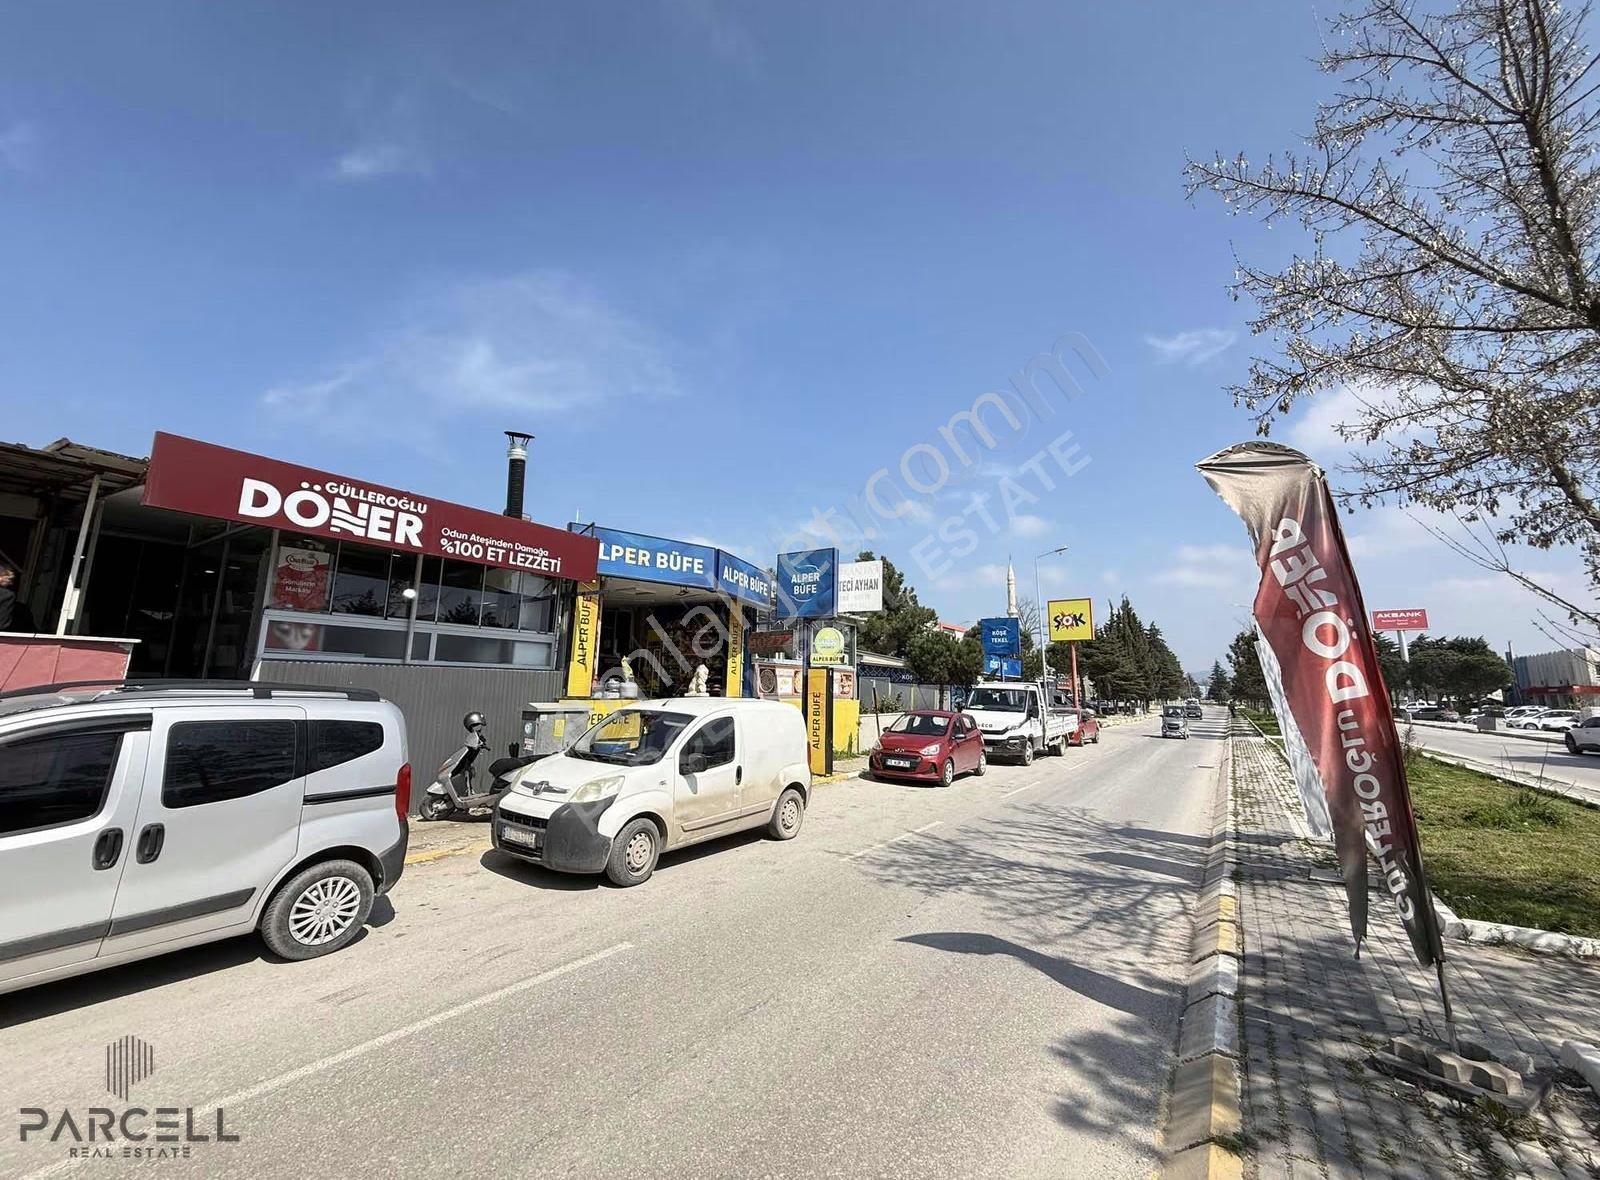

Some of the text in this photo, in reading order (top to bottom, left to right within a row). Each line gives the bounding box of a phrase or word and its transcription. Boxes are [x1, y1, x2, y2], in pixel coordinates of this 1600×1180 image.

[238, 477, 423, 547] DÖNER
[325, 481, 428, 514] GÜLLEROĞLU
[440, 538, 561, 573] %100 ET LEZZETİ
[441, 527, 549, 557] Odun Ateşinden Damağa
[599, 543, 704, 575] LPER BÜFE
[722, 565, 749, 589] ALPER
[750, 574, 768, 596] BÜFE
[791, 572, 820, 594] ALPER BÜFE
[854, 578, 879, 592] AYHAN
[1053, 612, 1086, 632] ŞOK
[1376, 611, 1422, 619] AKBANK
[577, 627, 588, 666] ALPER
[812, 718, 821, 750] ALPER
